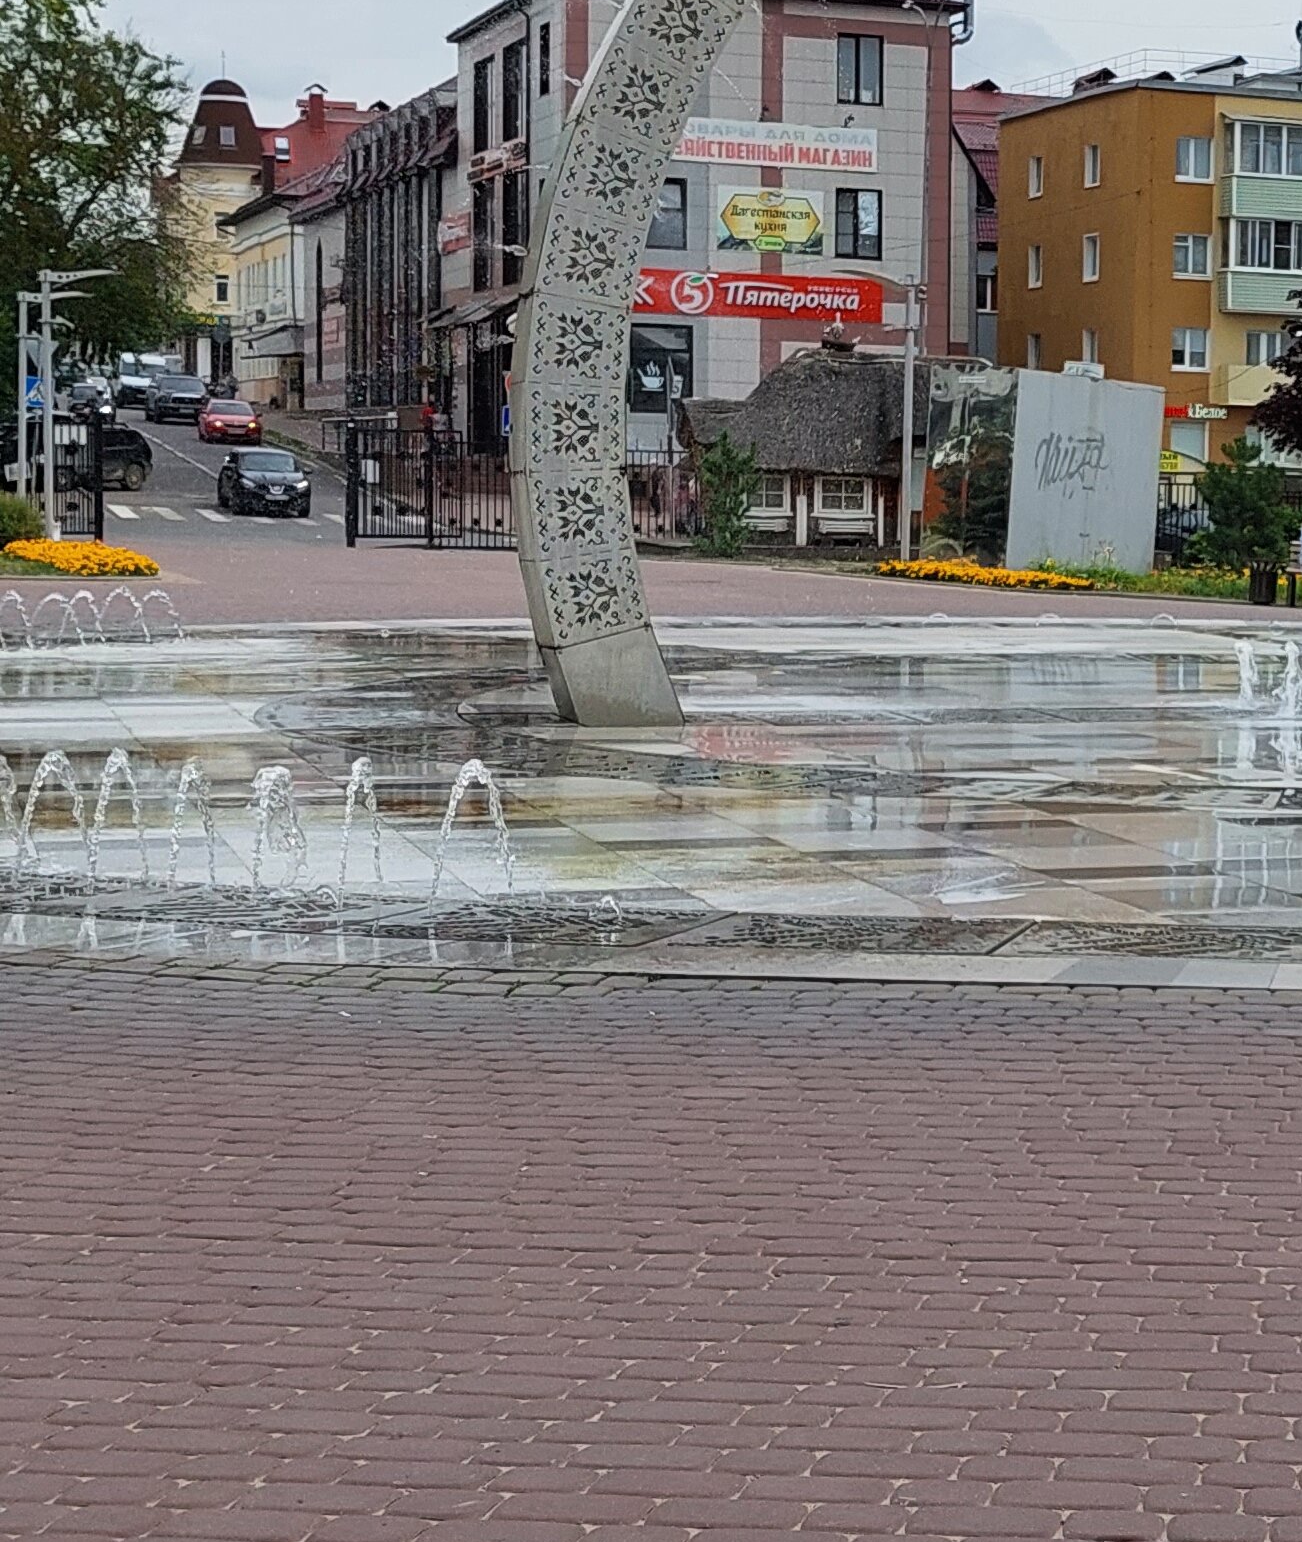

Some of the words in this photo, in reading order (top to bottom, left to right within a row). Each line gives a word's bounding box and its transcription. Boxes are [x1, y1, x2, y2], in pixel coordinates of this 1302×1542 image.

[686, 123, 756, 138] ОВАРЫ
[764, 129, 806, 141] ДЛЯ
[813, 132, 873, 146] ДОМА
[674, 135, 795, 163] ЗЯЙСТВЕННЫЙ
[798, 146, 874, 168] МАГАЗИН
[730, 204, 811, 220] Дагестанская
[719, 281, 860, 313] Пятерочка
